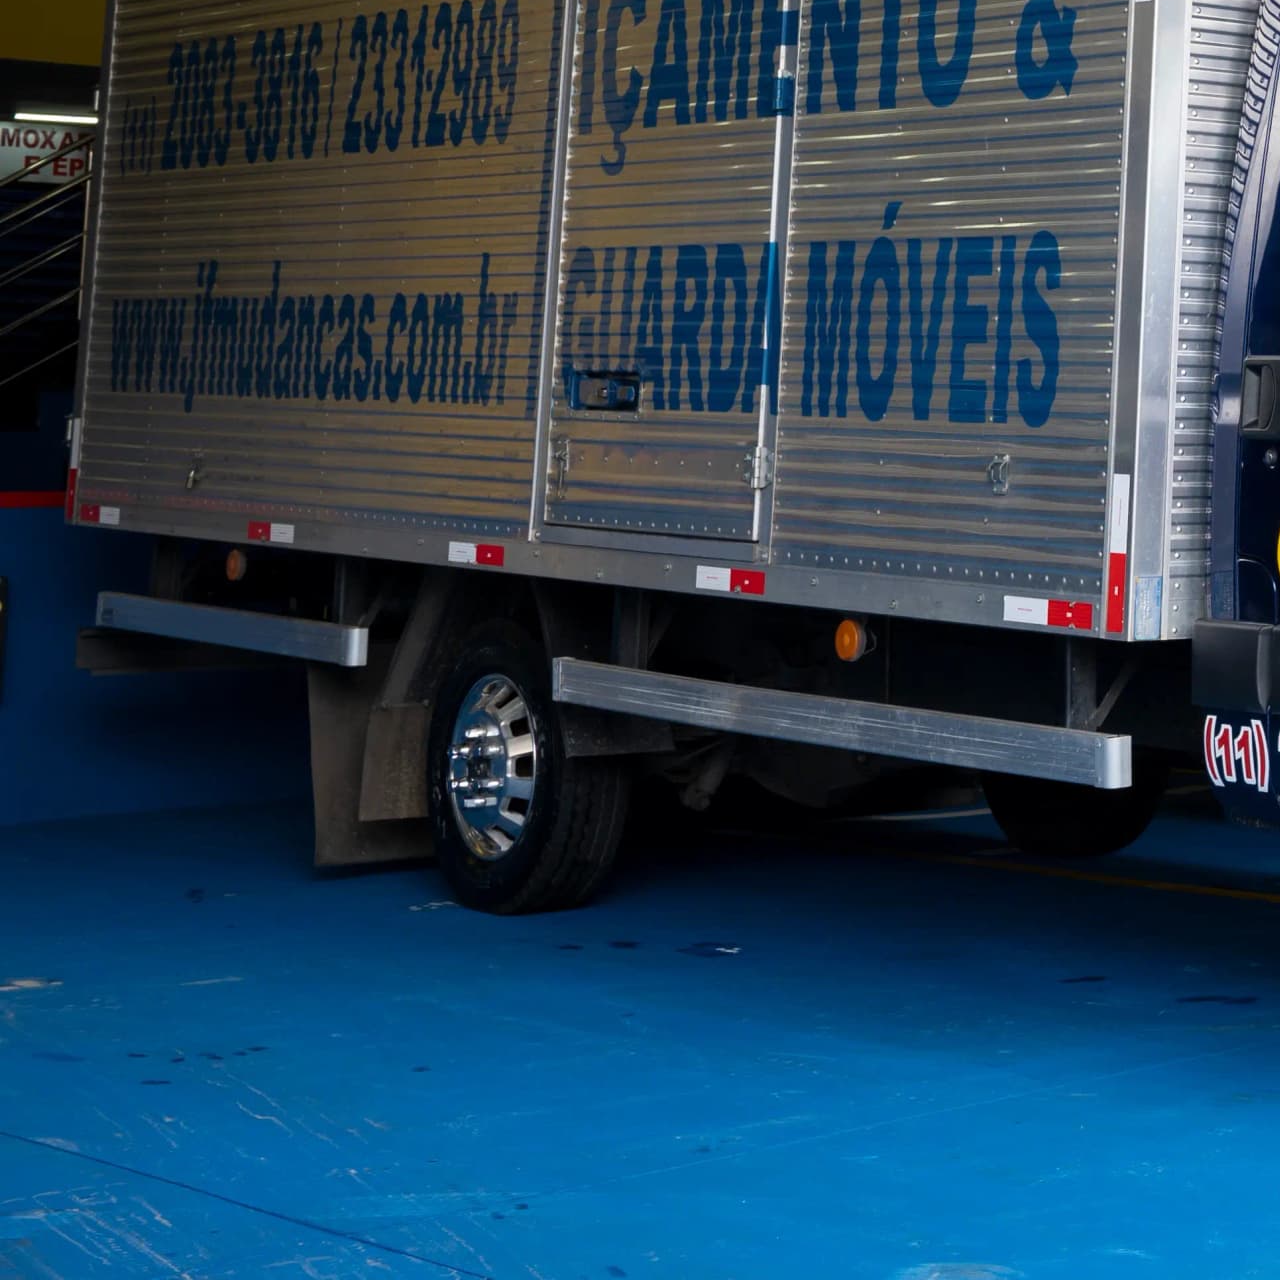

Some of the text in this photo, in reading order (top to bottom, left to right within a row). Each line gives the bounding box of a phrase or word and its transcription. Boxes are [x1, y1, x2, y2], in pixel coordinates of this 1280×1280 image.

[161, 23, 323, 171] 2083-3816
[562, 201, 1063, 428] GUARDA MÓVEIS
[1204, 716, 1270, 792] (11)
